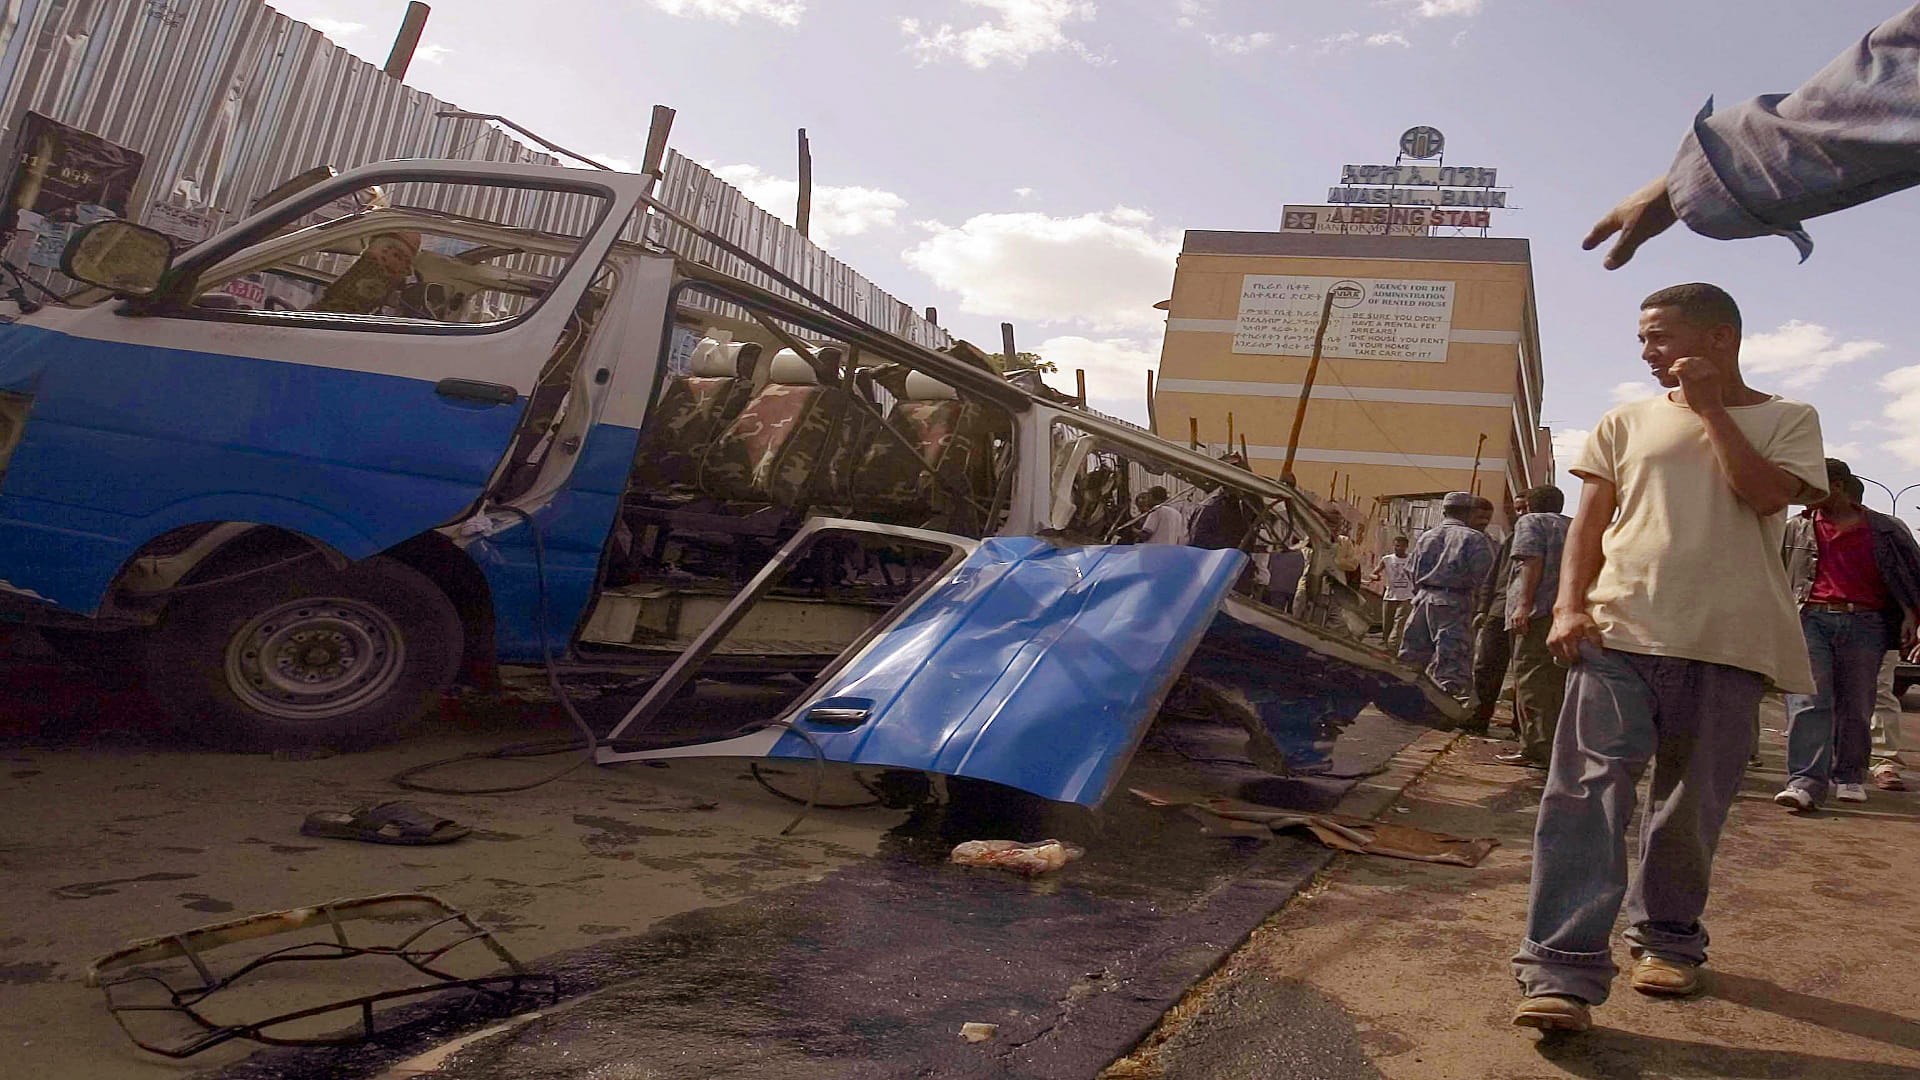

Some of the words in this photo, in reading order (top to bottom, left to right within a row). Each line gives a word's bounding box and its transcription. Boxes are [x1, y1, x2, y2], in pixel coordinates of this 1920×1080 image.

[1329, 188, 1403, 204] AWASH
[1441, 190, 1505, 207] BANK
[1352, 208, 1424, 225] RISING
[1430, 210, 1488, 227] STAR
[1374, 291, 1446, 300] ADMINISTRATION
